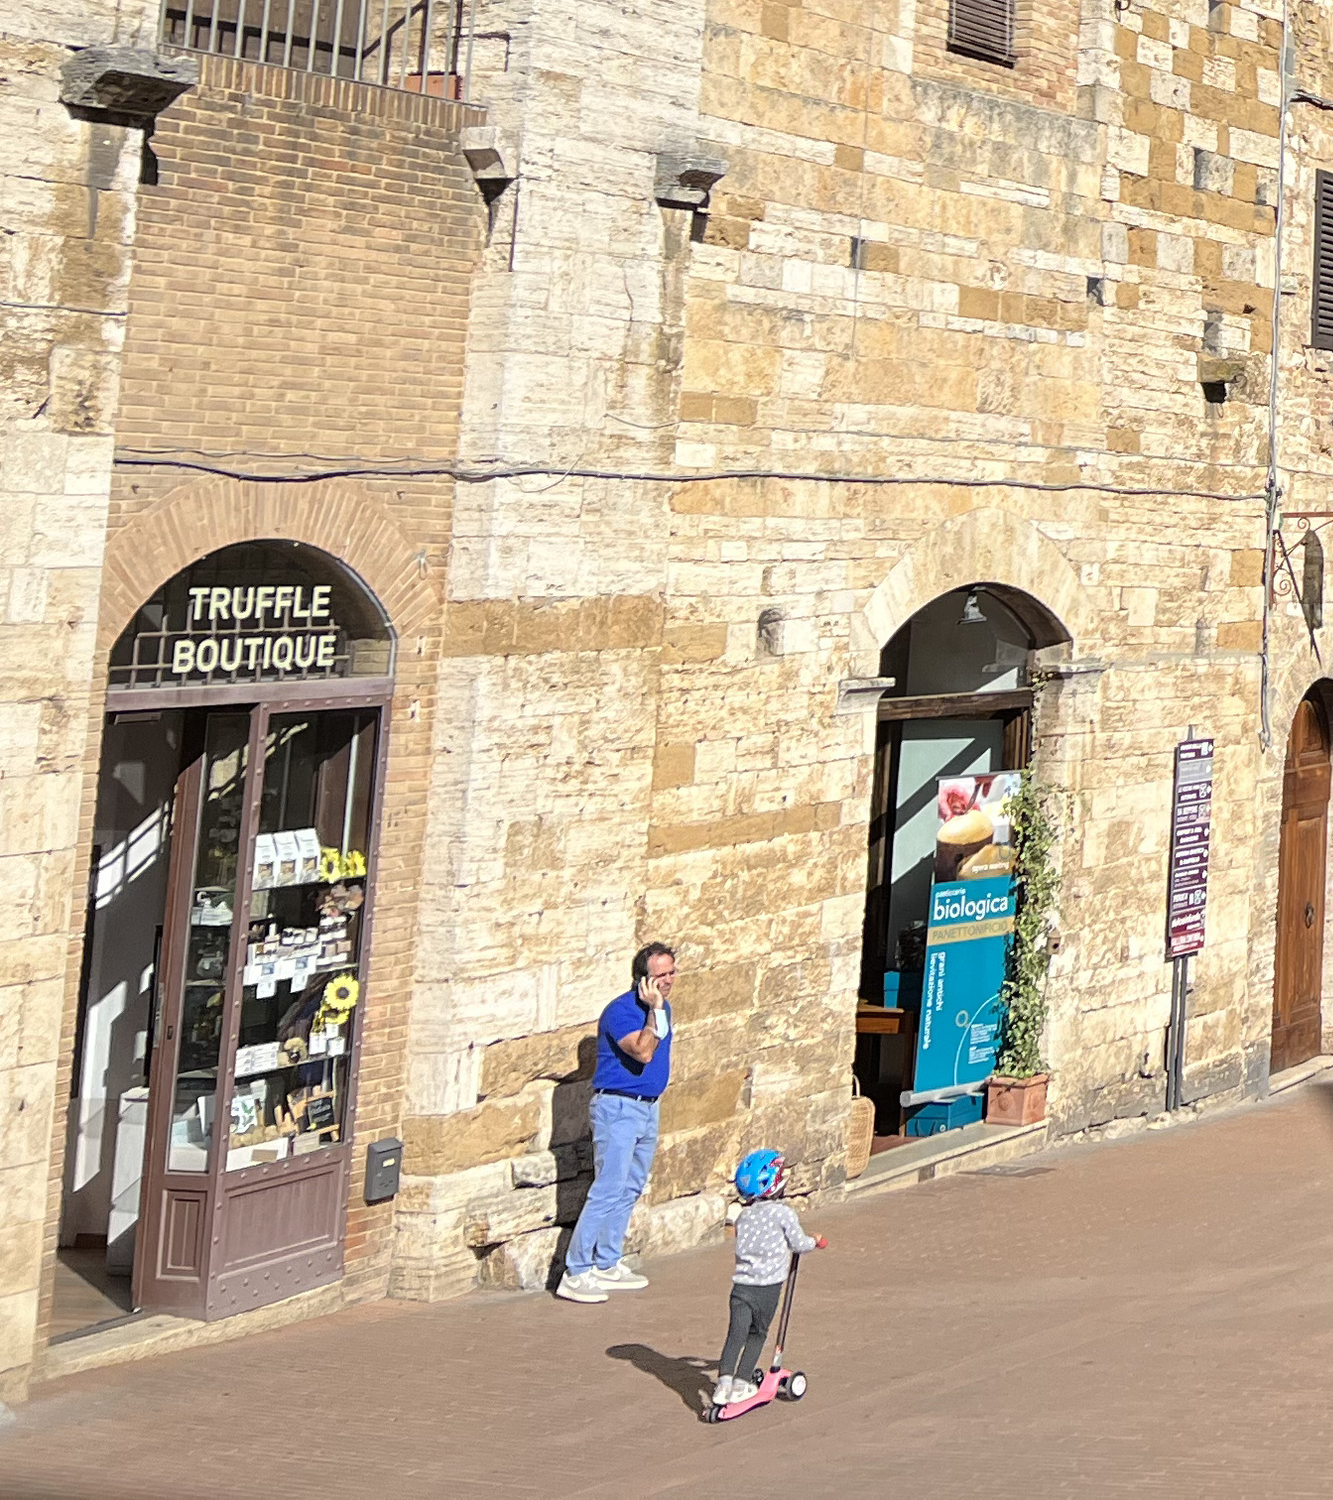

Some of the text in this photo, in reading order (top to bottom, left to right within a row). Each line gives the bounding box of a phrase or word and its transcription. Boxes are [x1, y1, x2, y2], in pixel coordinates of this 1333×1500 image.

[188, 585, 332, 621] TRUFFLE
[171, 635, 337, 674] BOUTIQUE
[933, 893, 1009, 921] biologica
[932, 920, 1008, 939] PANETTONIFICIO
[936, 951, 946, 1011] grani antichi
[922, 952, 938, 1050] lievitazione naturale
